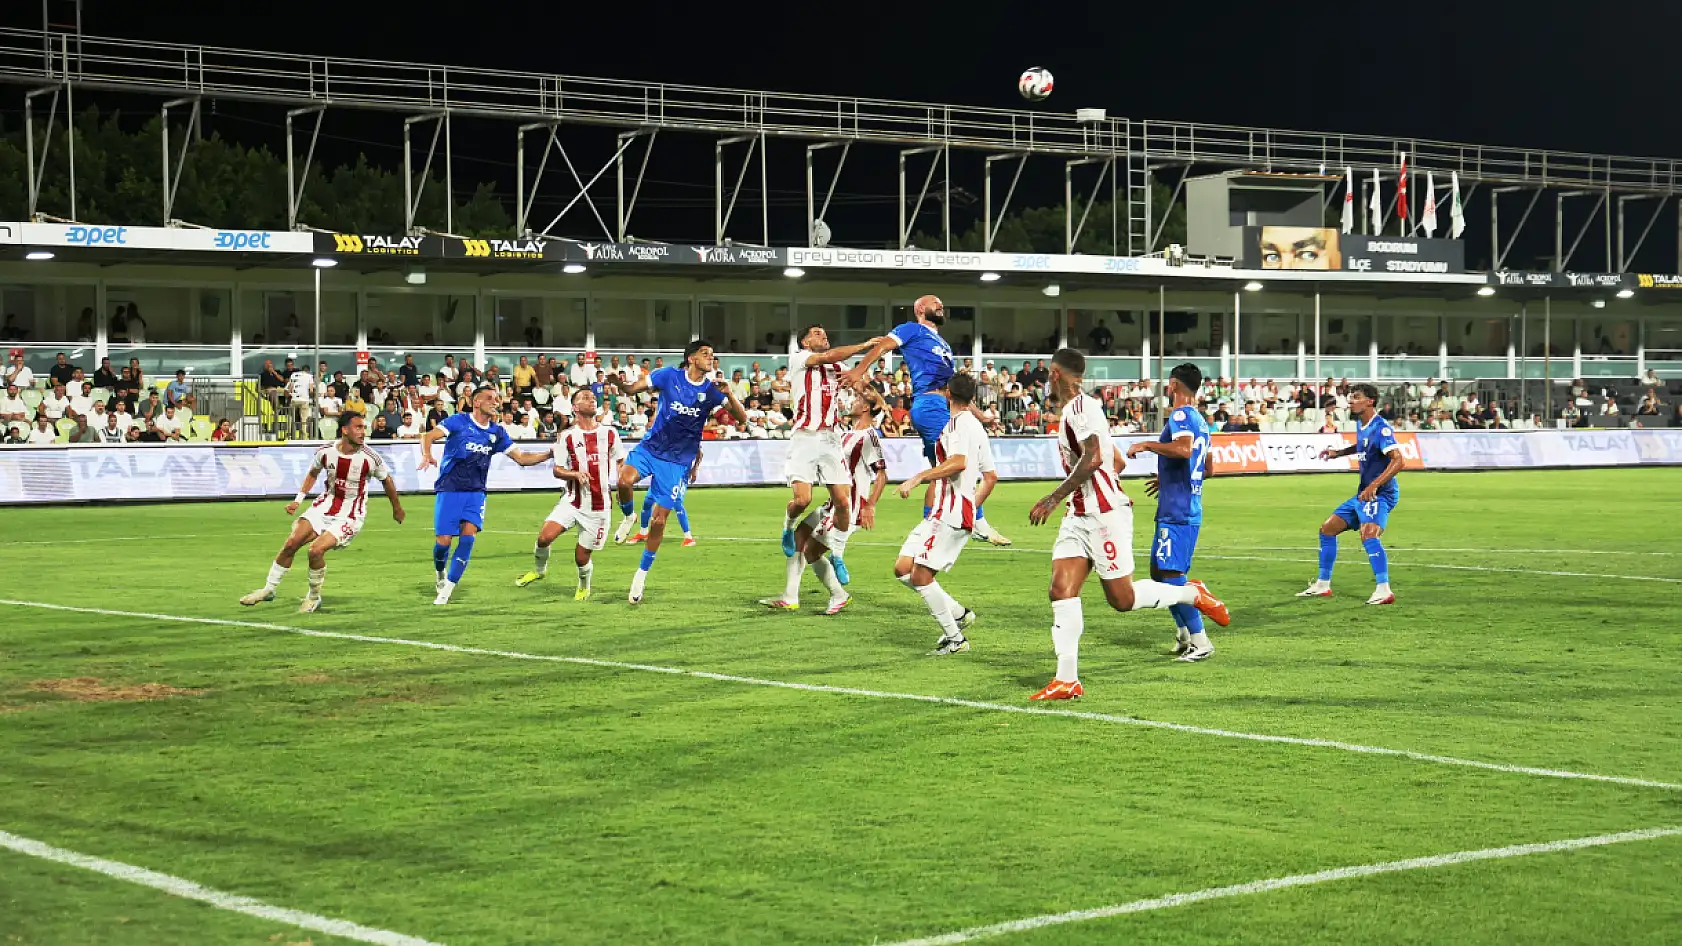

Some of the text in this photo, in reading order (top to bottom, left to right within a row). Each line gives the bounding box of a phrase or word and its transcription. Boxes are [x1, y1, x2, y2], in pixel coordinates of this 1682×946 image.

[65, 227, 127, 246] opet
[214, 232, 270, 250] opet
[363, 235, 424, 249] TALAY
[491, 239, 547, 253] TALAY
[628, 246, 670, 256] ACROPOL
[738, 248, 779, 259] ACROPOL
[1367, 241, 1418, 254] BODRUM
[595, 249, 624, 260] AURA
[708, 252, 736, 262] AURA
[793, 249, 883, 265] grey beton
[894, 252, 982, 267] grey beton
[1386, 260, 1449, 273] STADYUMU
[670, 401, 702, 417] opet
[1563, 435, 1630, 451] TALAY
[70, 454, 211, 479] TALAY
[1363, 501, 1378, 517] 41
[597, 527, 605, 540] 6
[924, 535, 936, 551] 4
[1155, 538, 1172, 557] 21
[1103, 541, 1118, 561] 9
